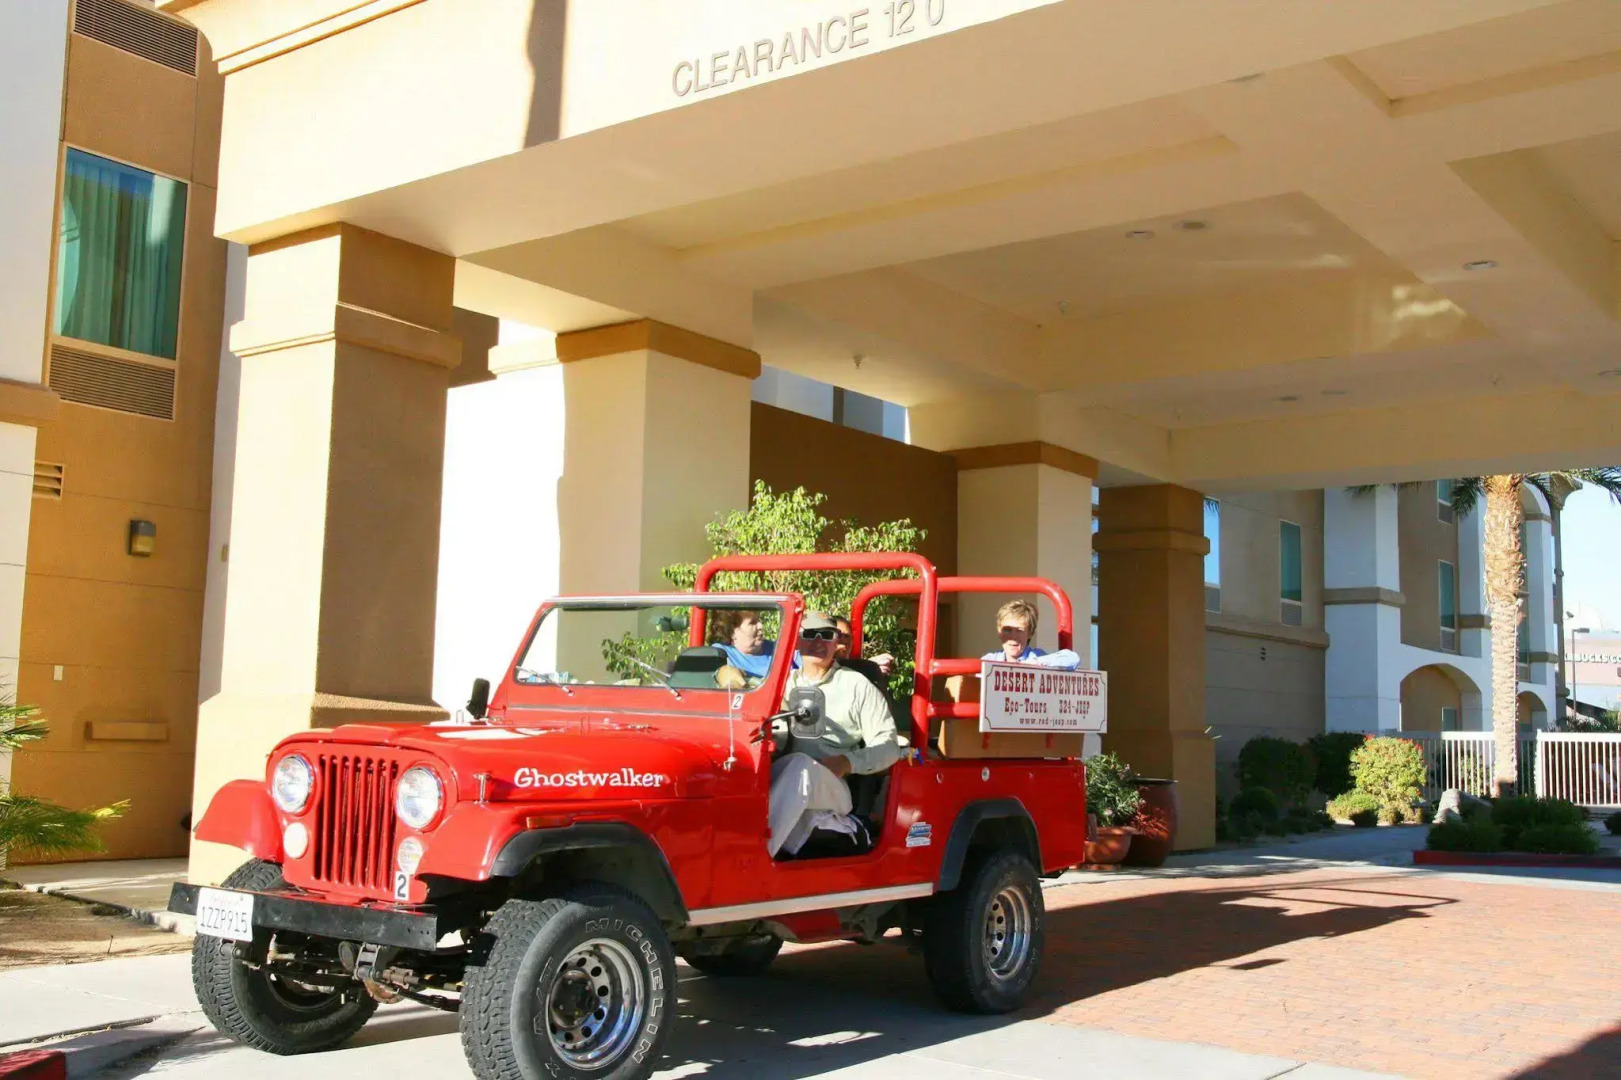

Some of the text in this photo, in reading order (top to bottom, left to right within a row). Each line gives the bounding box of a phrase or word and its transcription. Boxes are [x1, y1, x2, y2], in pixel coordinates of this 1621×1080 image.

[672, 8, 869, 97] CLEARANCE
[884, 0, 915, 38] 12
[994, 670, 1099, 697] DESERT ADVENTURES
[733, 695, 742, 709] 2
[1059, 699, 1091, 715] 324-JEEP
[1019, 717, 1077, 727] www.red-jeep.com
[513, 767, 664, 788] Ghostwalker
[397, 873, 407, 898] 2
[200, 906, 248, 934] 1ZZP915
[585, 918, 664, 1064] MICHELIN
